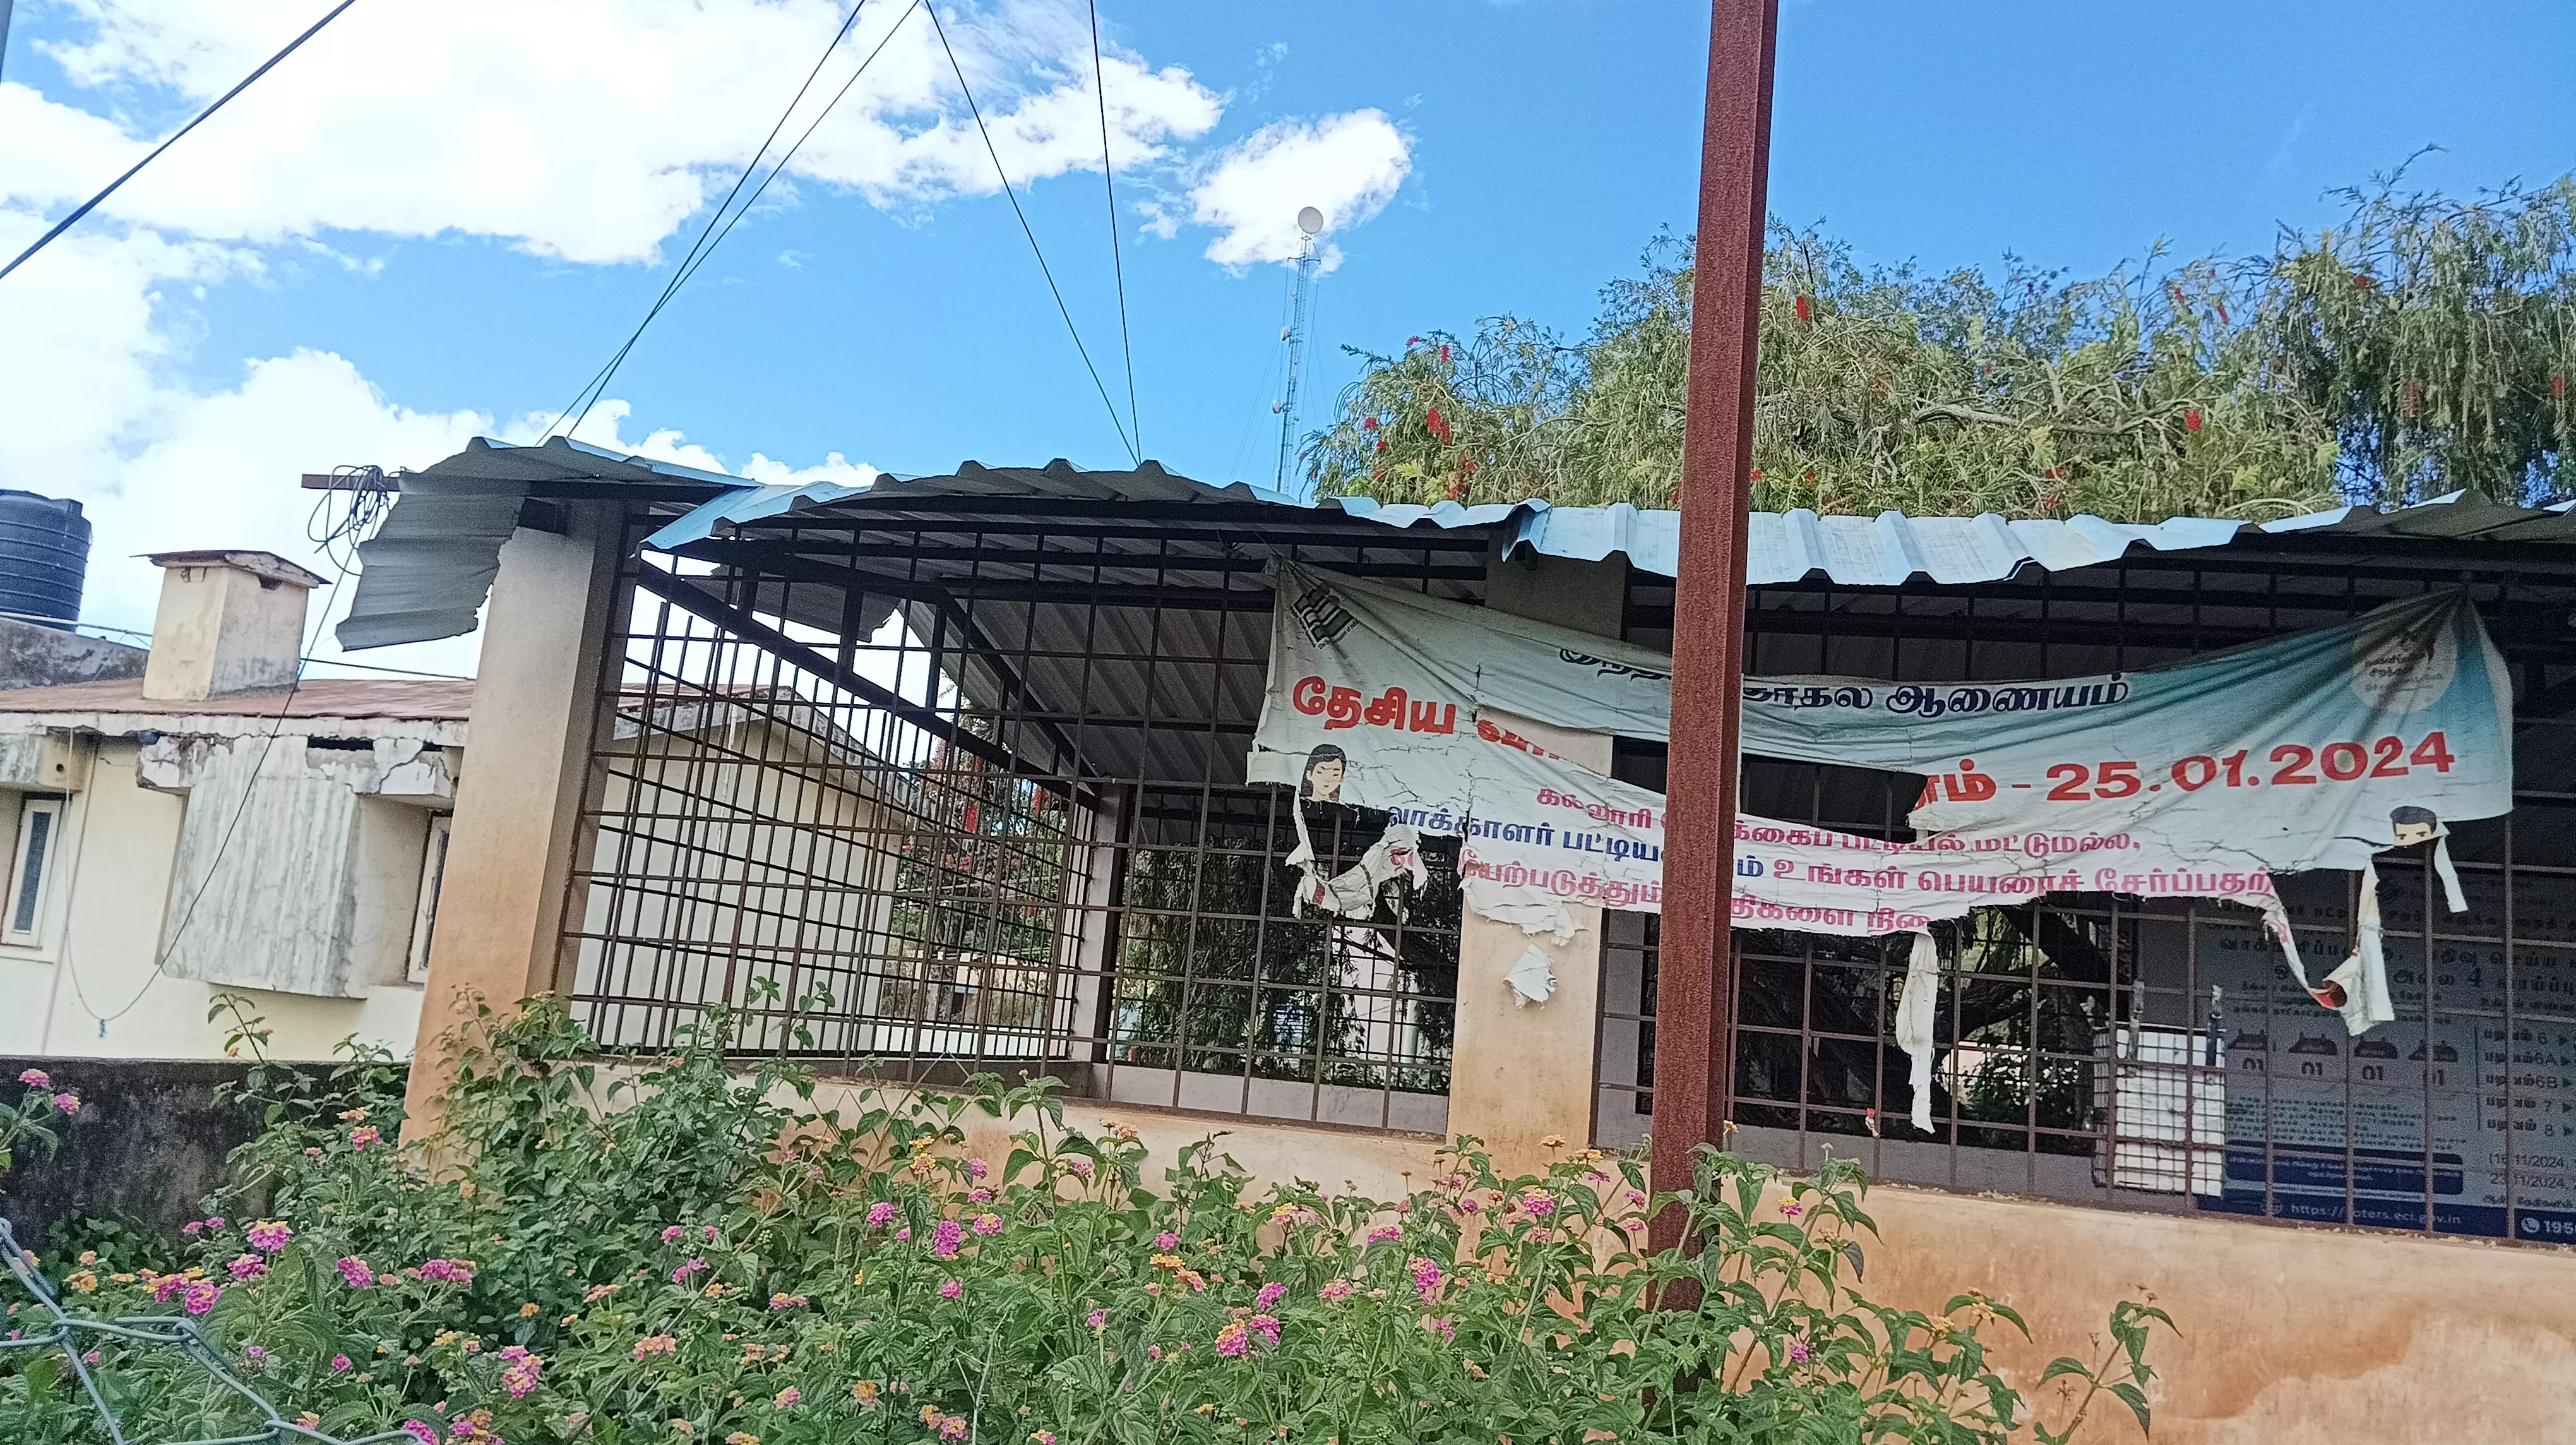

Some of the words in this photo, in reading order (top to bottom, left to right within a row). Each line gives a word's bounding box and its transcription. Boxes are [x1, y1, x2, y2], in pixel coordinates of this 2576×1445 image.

[1292, 675, 1457, 735] தேசிய
[1886, 673, 2128, 718] ஆணையம்
[2047, 731, 2455, 801] 25.01.2024
[1975, 832, 2140, 858] மட்டுமல்ல,
[1773, 857, 1909, 890] உங்கள்
[1917, 868, 2084, 894] பெயரைச்
[2467, 966, 2483, 988] 4
[2361, 1065, 2385, 1081] 01
